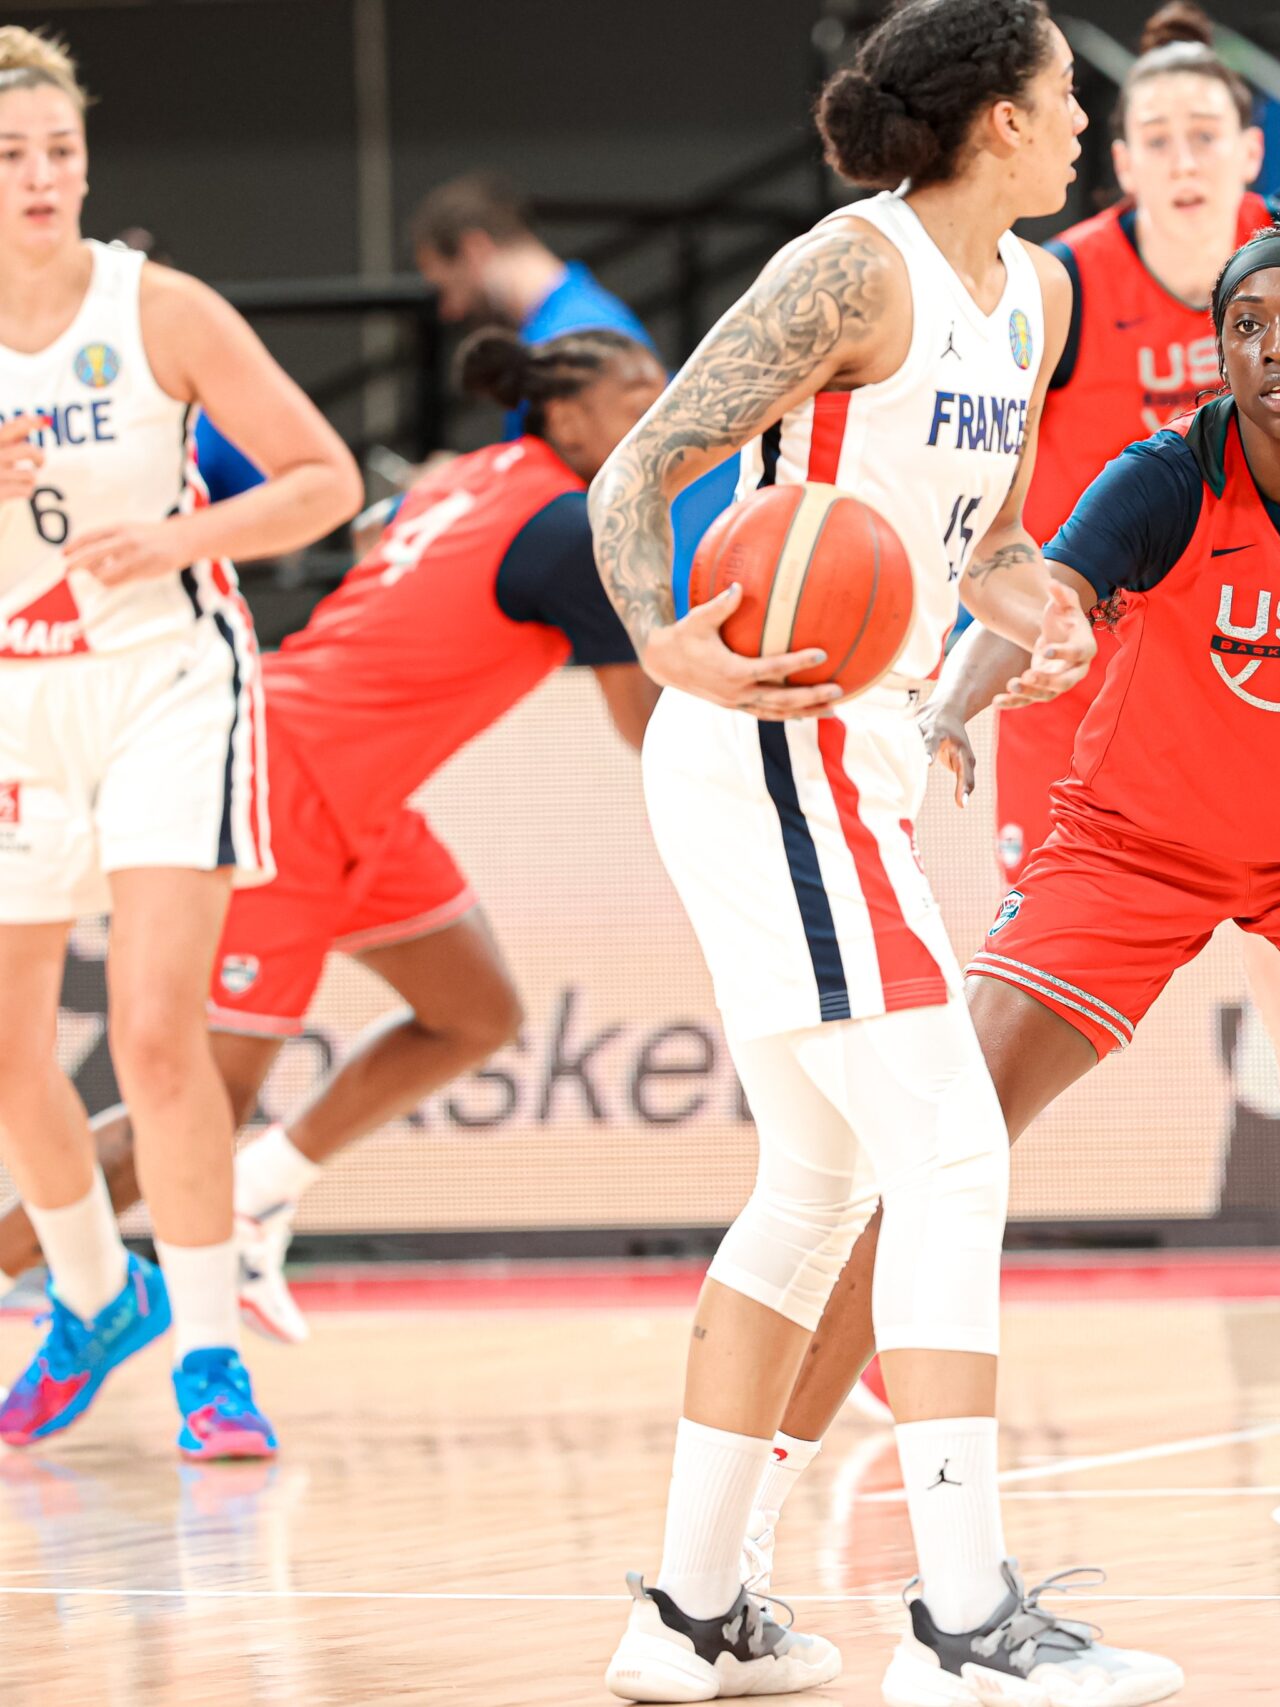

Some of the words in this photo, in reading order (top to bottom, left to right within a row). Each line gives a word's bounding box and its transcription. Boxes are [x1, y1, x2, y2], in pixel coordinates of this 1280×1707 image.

[1137, 335, 1220, 392] US
[926, 390, 1026, 455] FRANCE
[30, 487, 69, 545] 6
